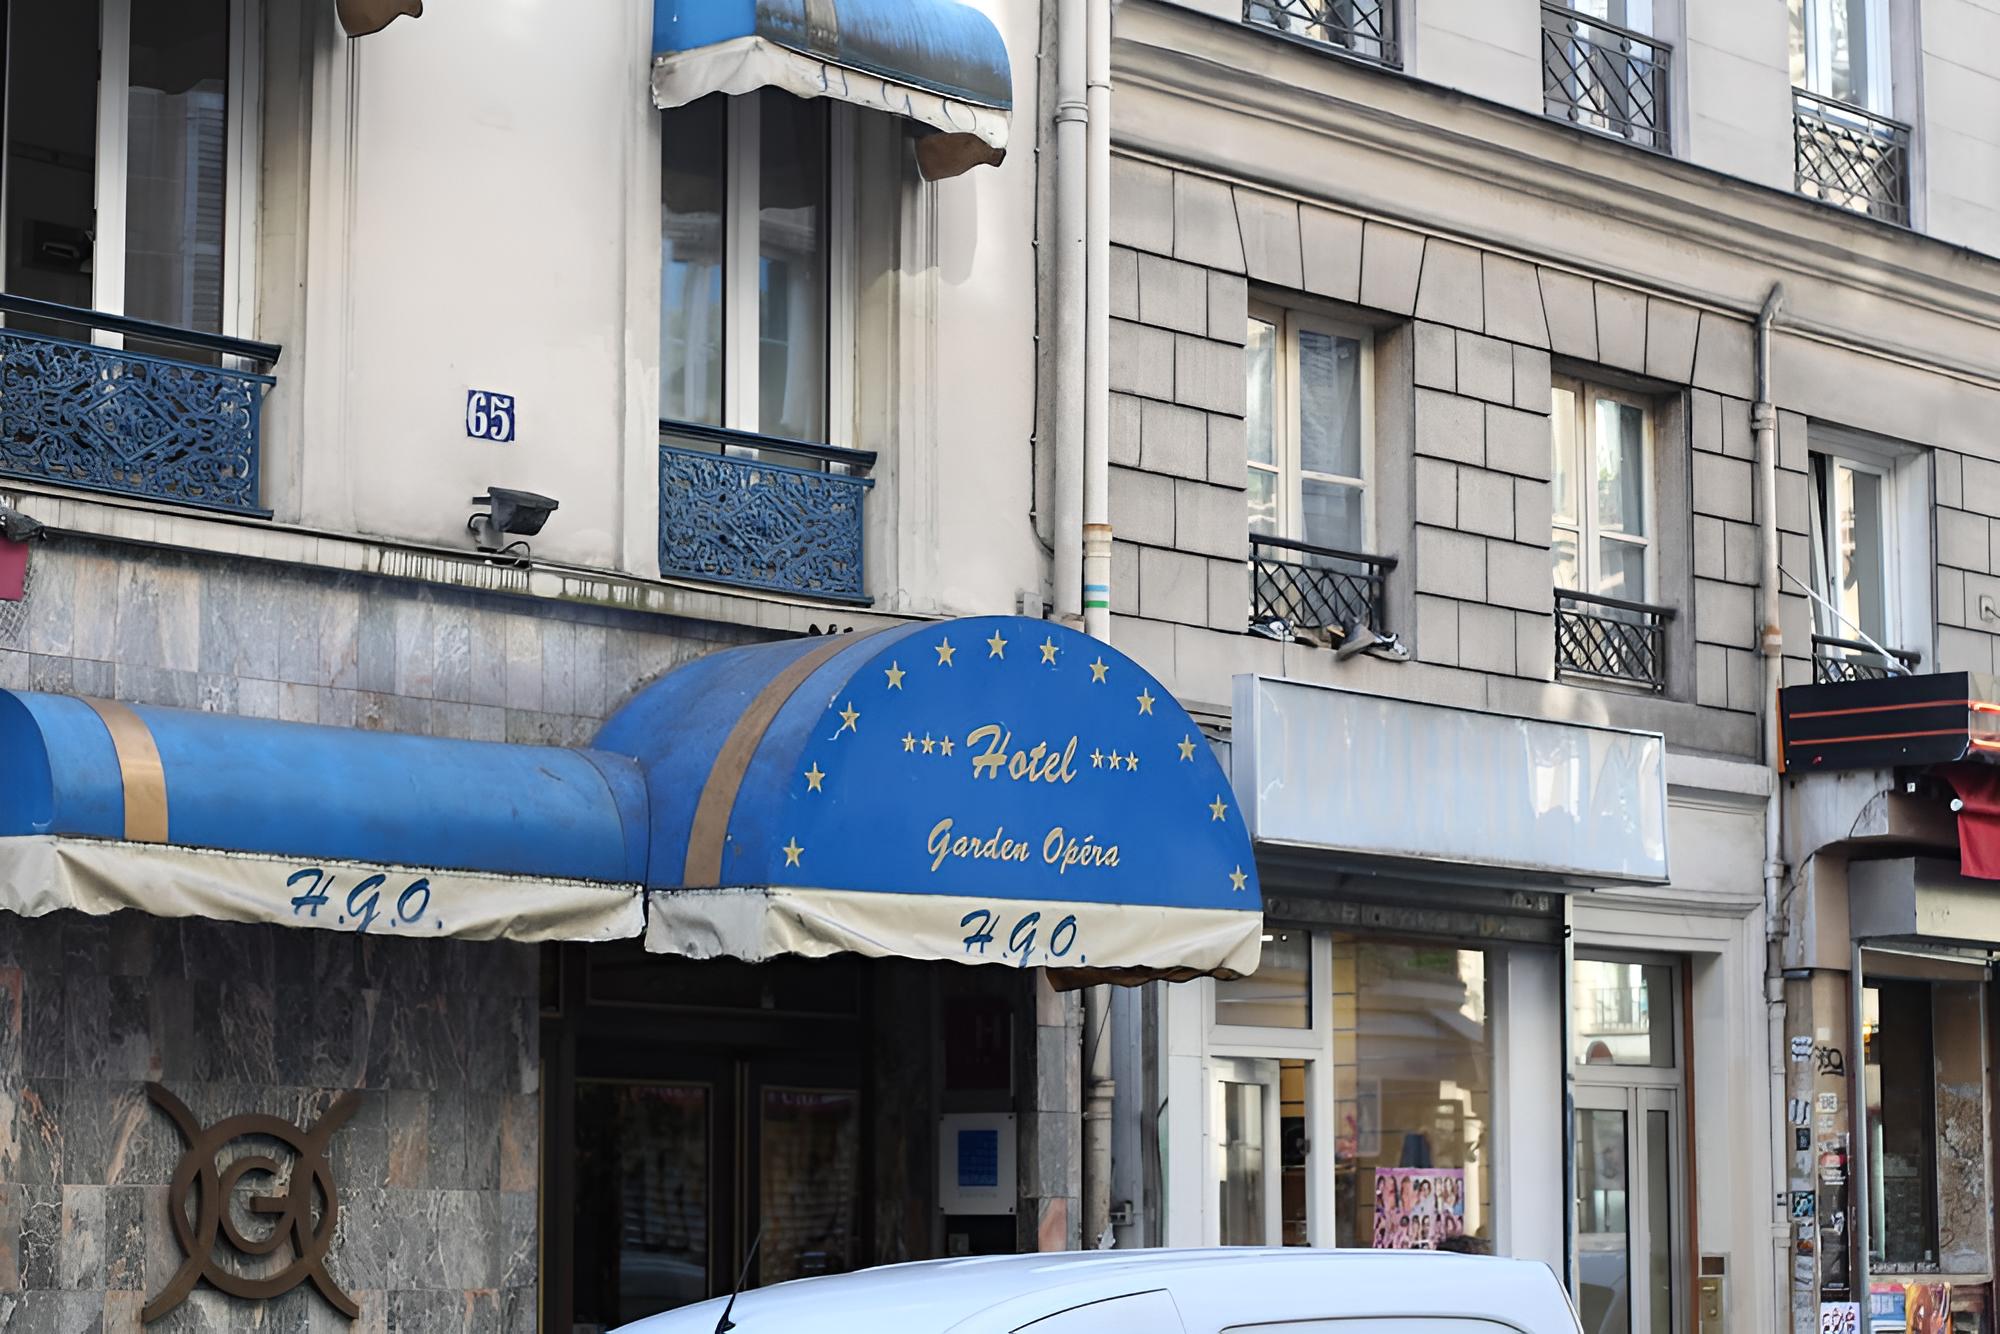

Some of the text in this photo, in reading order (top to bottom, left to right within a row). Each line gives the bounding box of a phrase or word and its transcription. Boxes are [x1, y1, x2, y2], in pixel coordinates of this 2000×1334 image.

[467, 391, 511, 441] 65
[966, 724, 1078, 783] Hotel
[927, 818, 1120, 874] Garden Opéra
